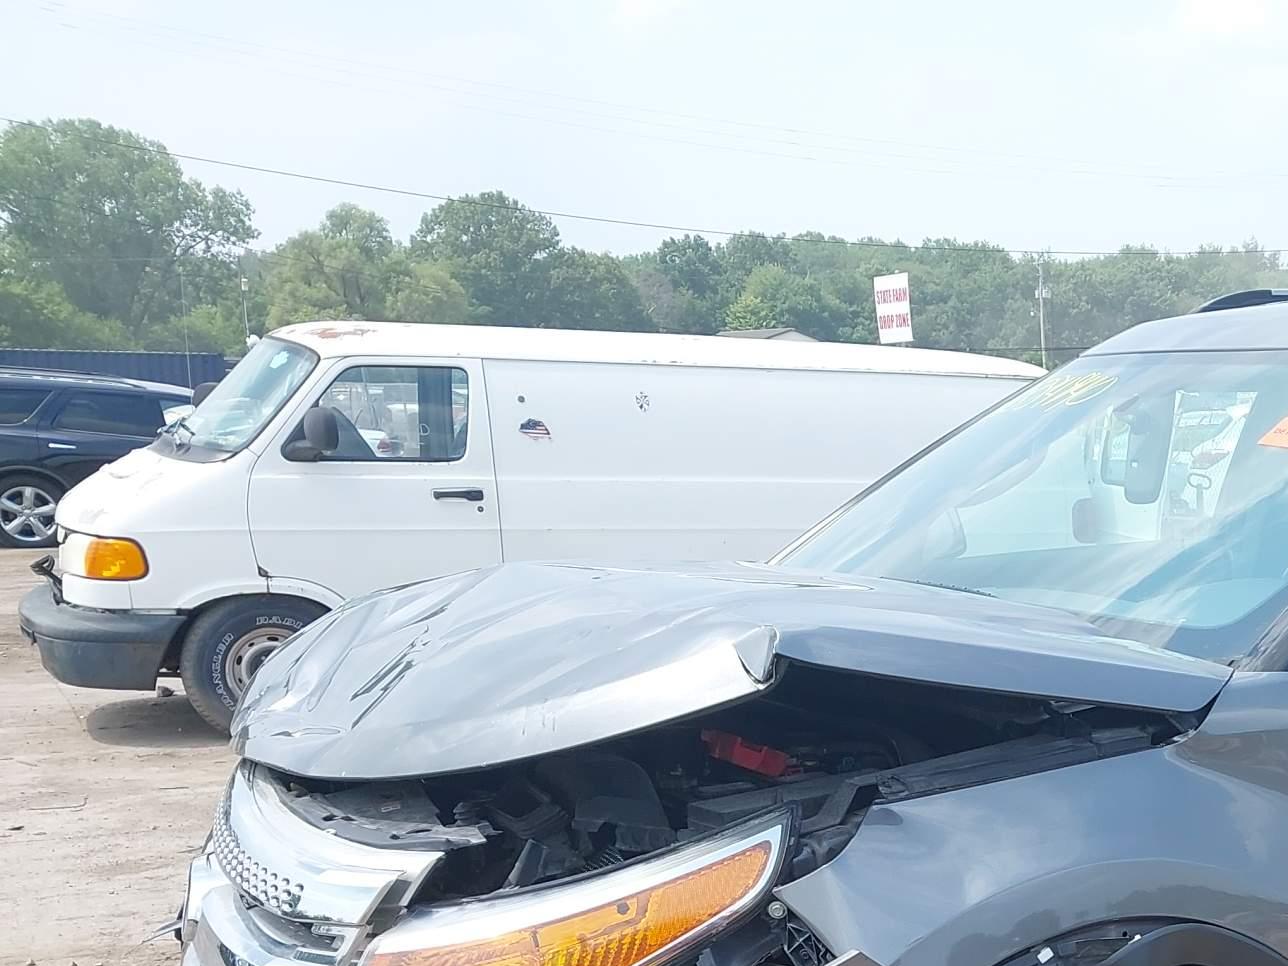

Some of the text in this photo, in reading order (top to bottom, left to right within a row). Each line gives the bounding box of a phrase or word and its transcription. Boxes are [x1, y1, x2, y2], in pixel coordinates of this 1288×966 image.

[876, 287, 908, 305] STATE FARM
[879, 312, 910, 330] DROP ZONE
